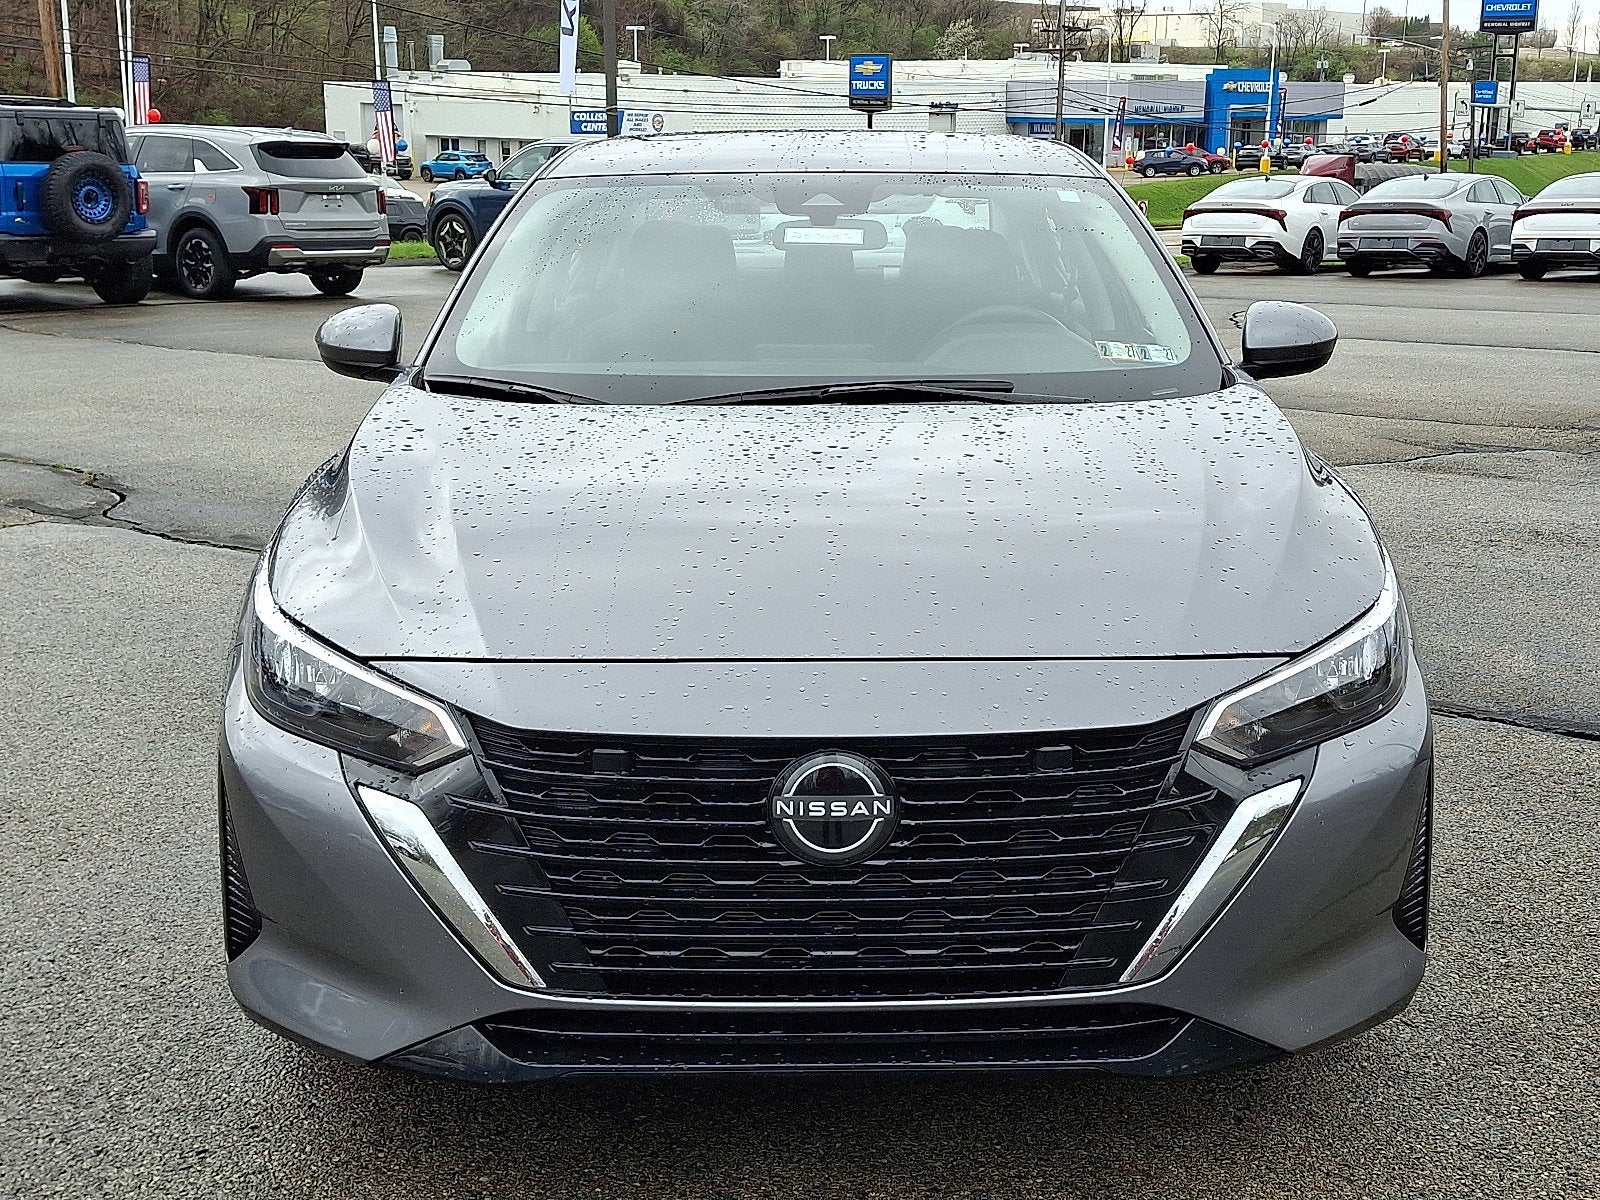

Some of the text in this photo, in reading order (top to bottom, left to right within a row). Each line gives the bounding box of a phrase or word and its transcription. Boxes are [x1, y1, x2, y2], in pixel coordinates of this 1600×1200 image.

[1485, 3, 1531, 11] CHEVROLET
[851, 80, 885, 89] TRUCKS
[581, 122, 608, 132] CENTE
[776, 800, 890, 817] NISSAN
